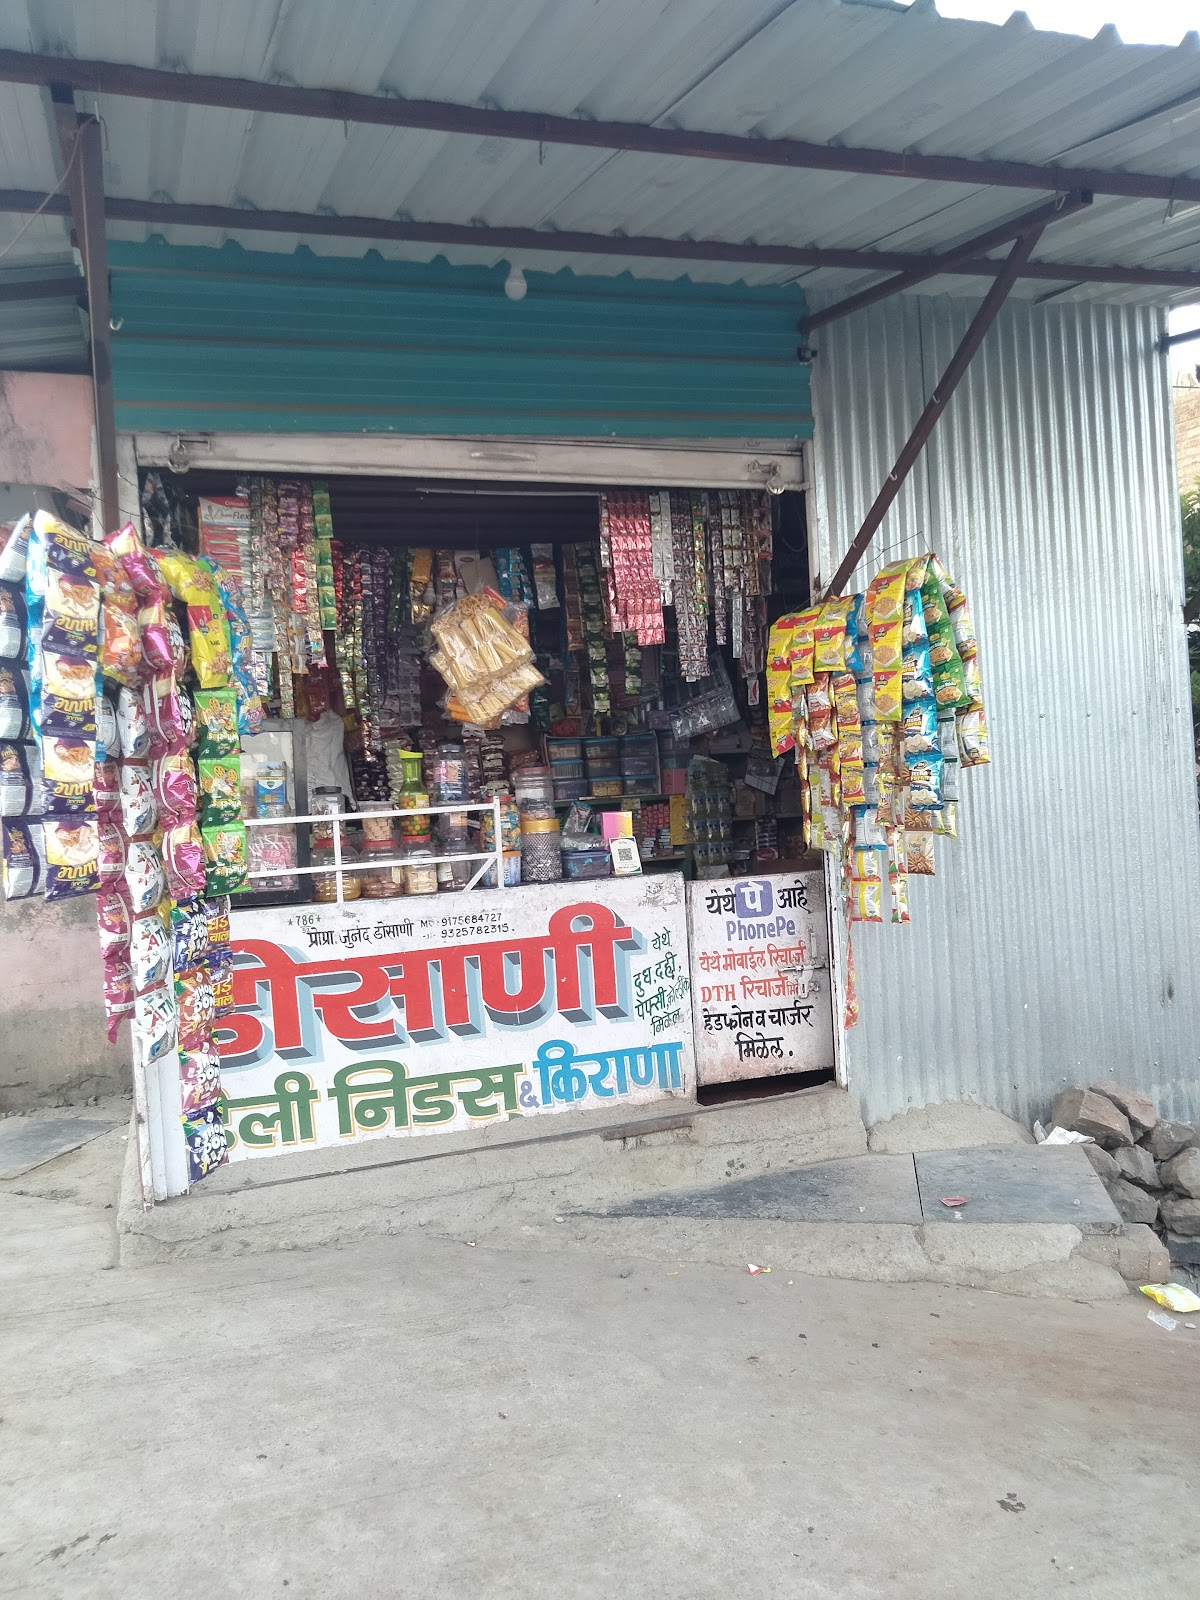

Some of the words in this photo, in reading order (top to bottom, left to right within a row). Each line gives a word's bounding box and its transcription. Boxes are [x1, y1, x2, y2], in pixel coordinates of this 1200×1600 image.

[706, 888, 736, 915] येथे
[740, 881, 764, 913] पे
[776, 879, 812, 914] आहे
[441, 912, 502, 927] 9175684727
[726, 915, 796, 942] PhonePe
[699, 951, 721, 973] येथे
[701, 983, 737, 1003] DTH
[740, 971, 789, 1001] रिचार्ज
[703, 1004, 754, 1036] हेडफोन
[768, 1000, 814, 1028] चार्जर
[532, 1039, 684, 1106] किराणा
[519, 1080, 541, 1108] &
